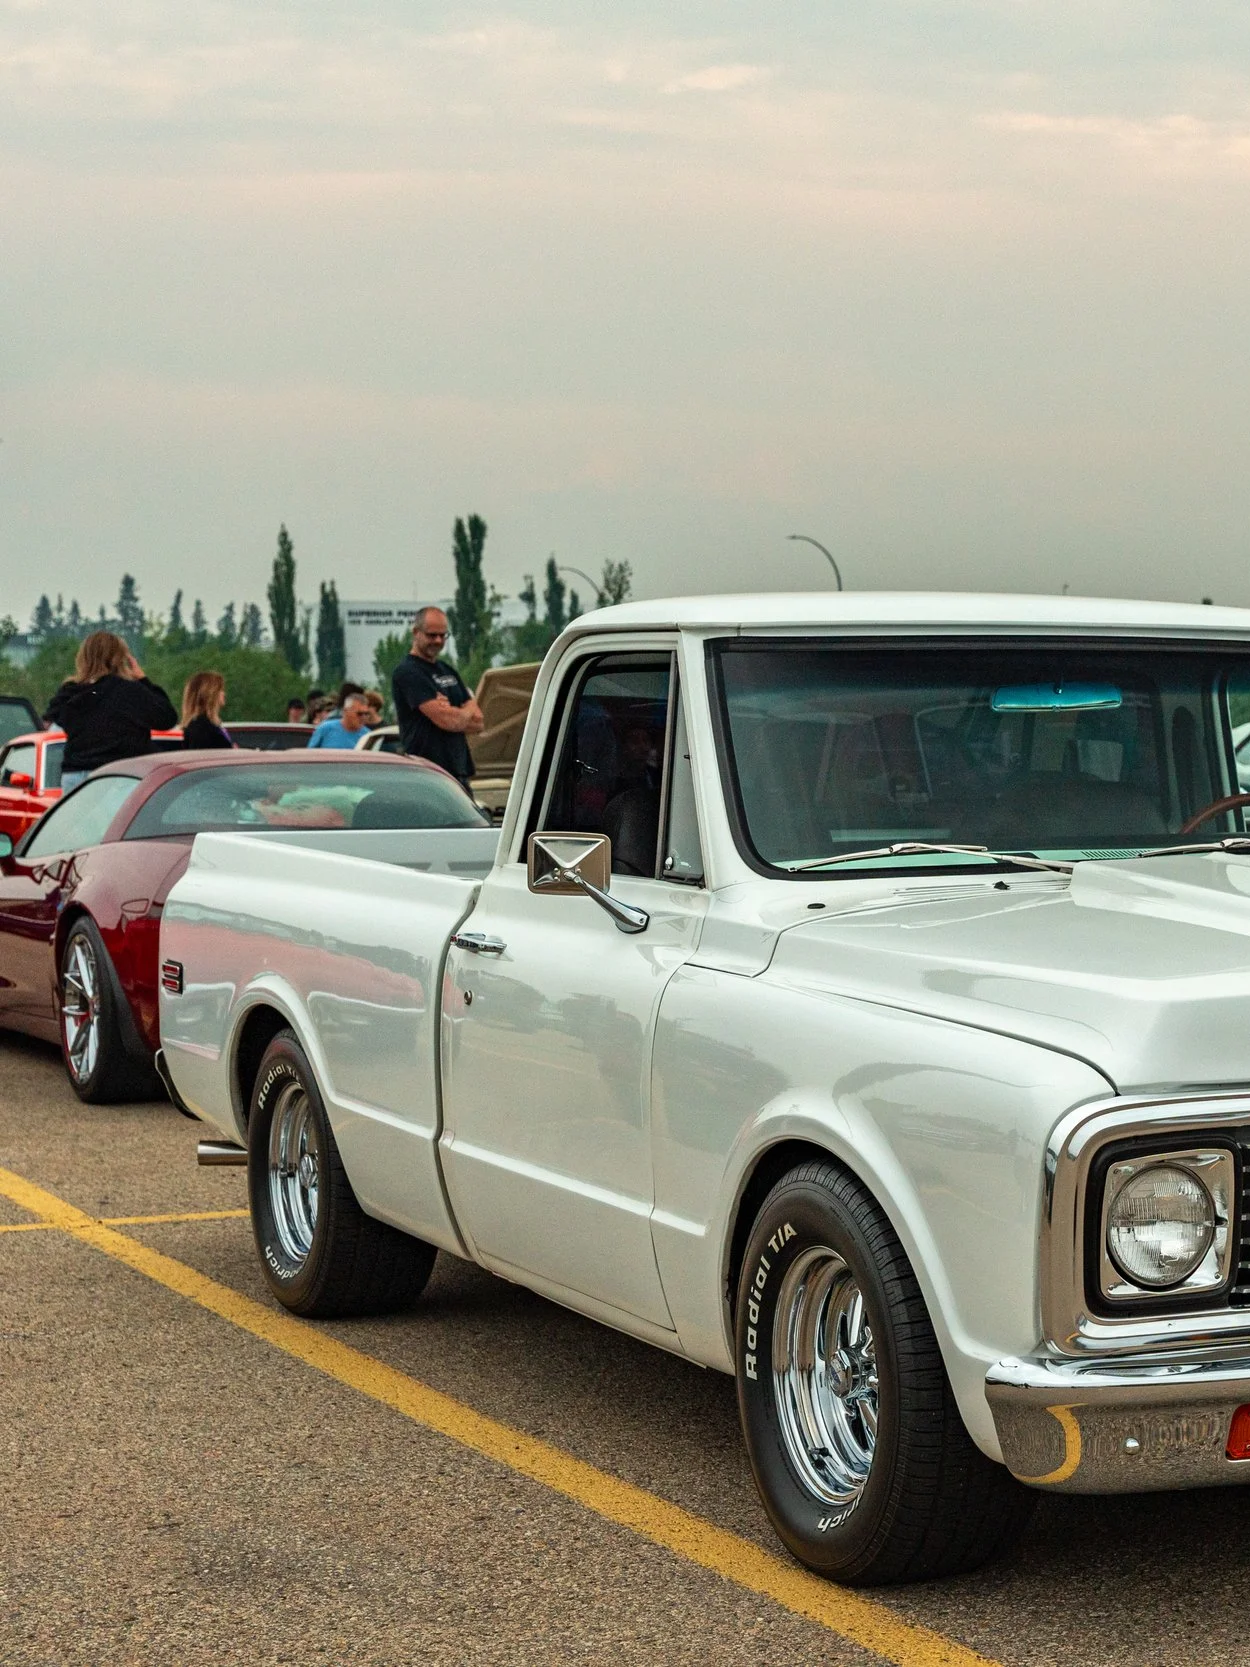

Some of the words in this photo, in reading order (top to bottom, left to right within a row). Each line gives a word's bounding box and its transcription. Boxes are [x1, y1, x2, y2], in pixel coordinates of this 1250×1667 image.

[257, 1063, 286, 1110] Radial
[745, 1255, 771, 1381] Radial
[767, 1221, 798, 1254] T/A
